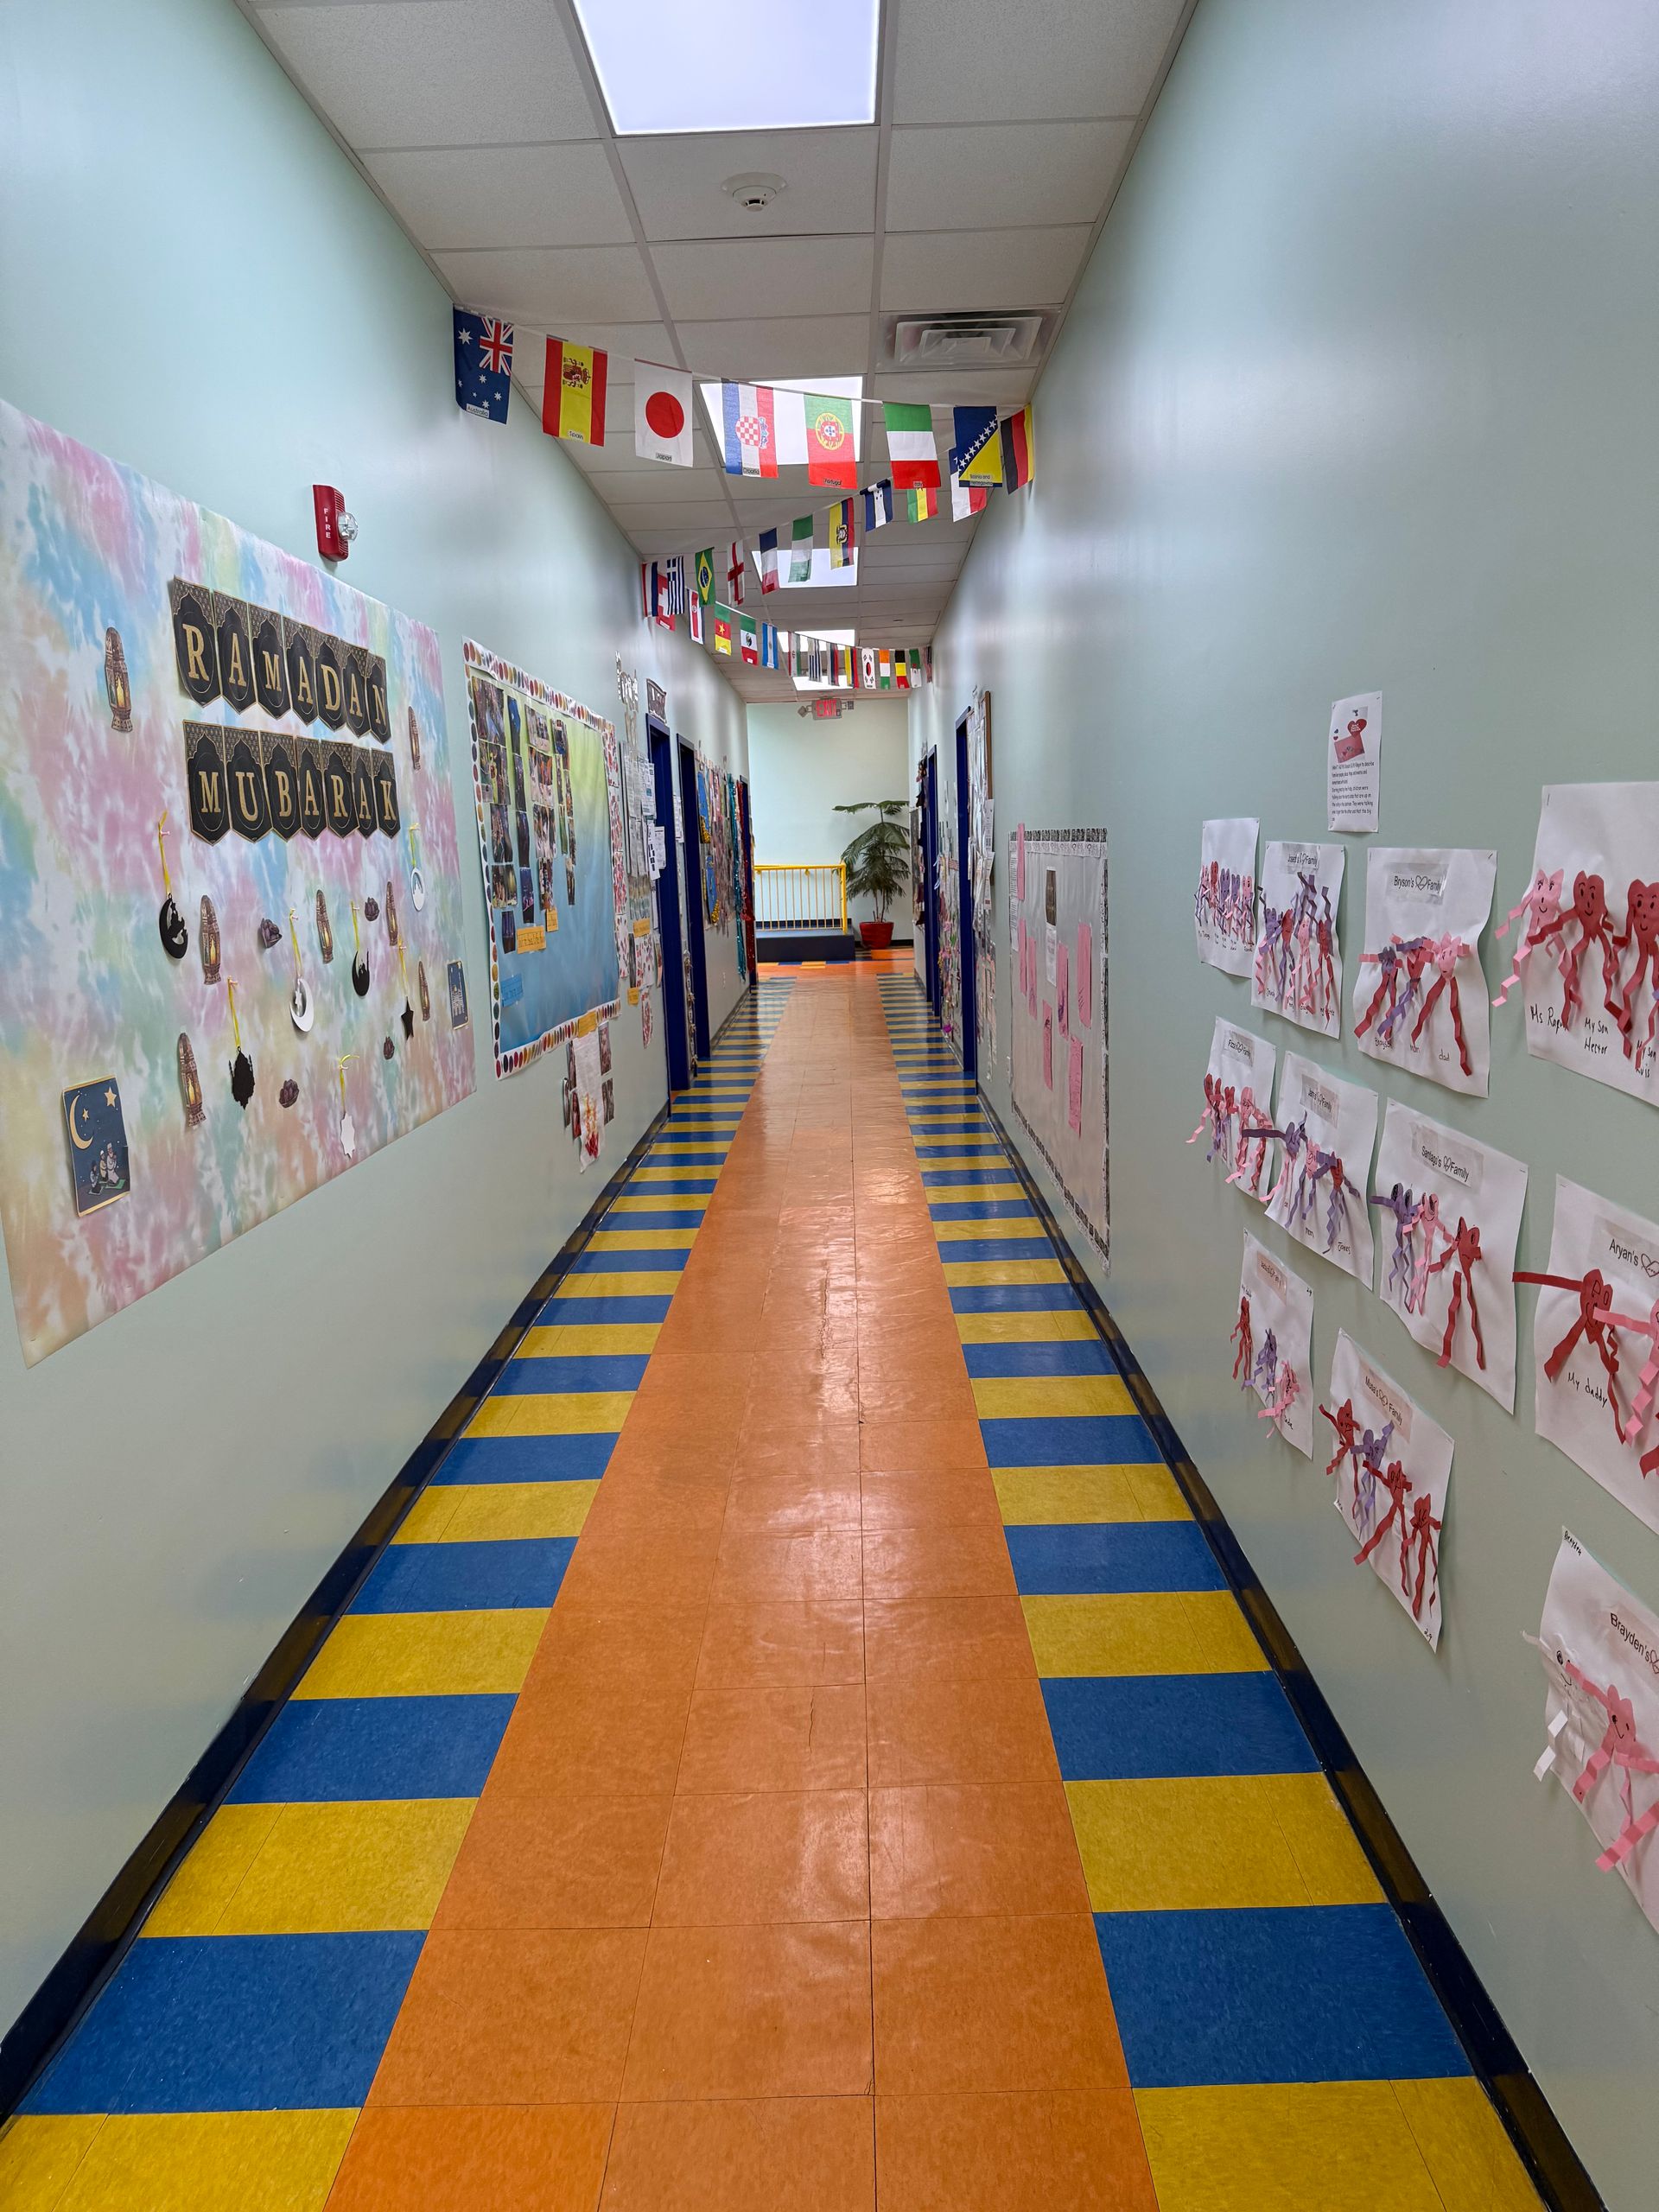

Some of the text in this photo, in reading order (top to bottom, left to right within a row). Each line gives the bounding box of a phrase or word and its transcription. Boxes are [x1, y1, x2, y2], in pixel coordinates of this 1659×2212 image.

[569, 430, 584, 440] Spain
[656, 453, 671, 461] Japan
[182, 623, 386, 726] RAMADAN
[816, 699, 837, 716] EXIT
[199, 770, 397, 821] MUBARAK
[1394, 875, 1441, 893] Bryson's Family
[1530, 1003, 1543, 1023] Ms
[1585, 1017, 1609, 1034] My Son
[1585, 1037, 1608, 1054] Hector
[1451, 1161, 1470, 1183] Family
[1609, 1238, 1639, 1267] Aryan's
[1567, 1372, 1607, 1408] My daddy
[1389, 1403, 1402, 1426] Family
[1610, 1612, 1650, 1662] Brayden's
